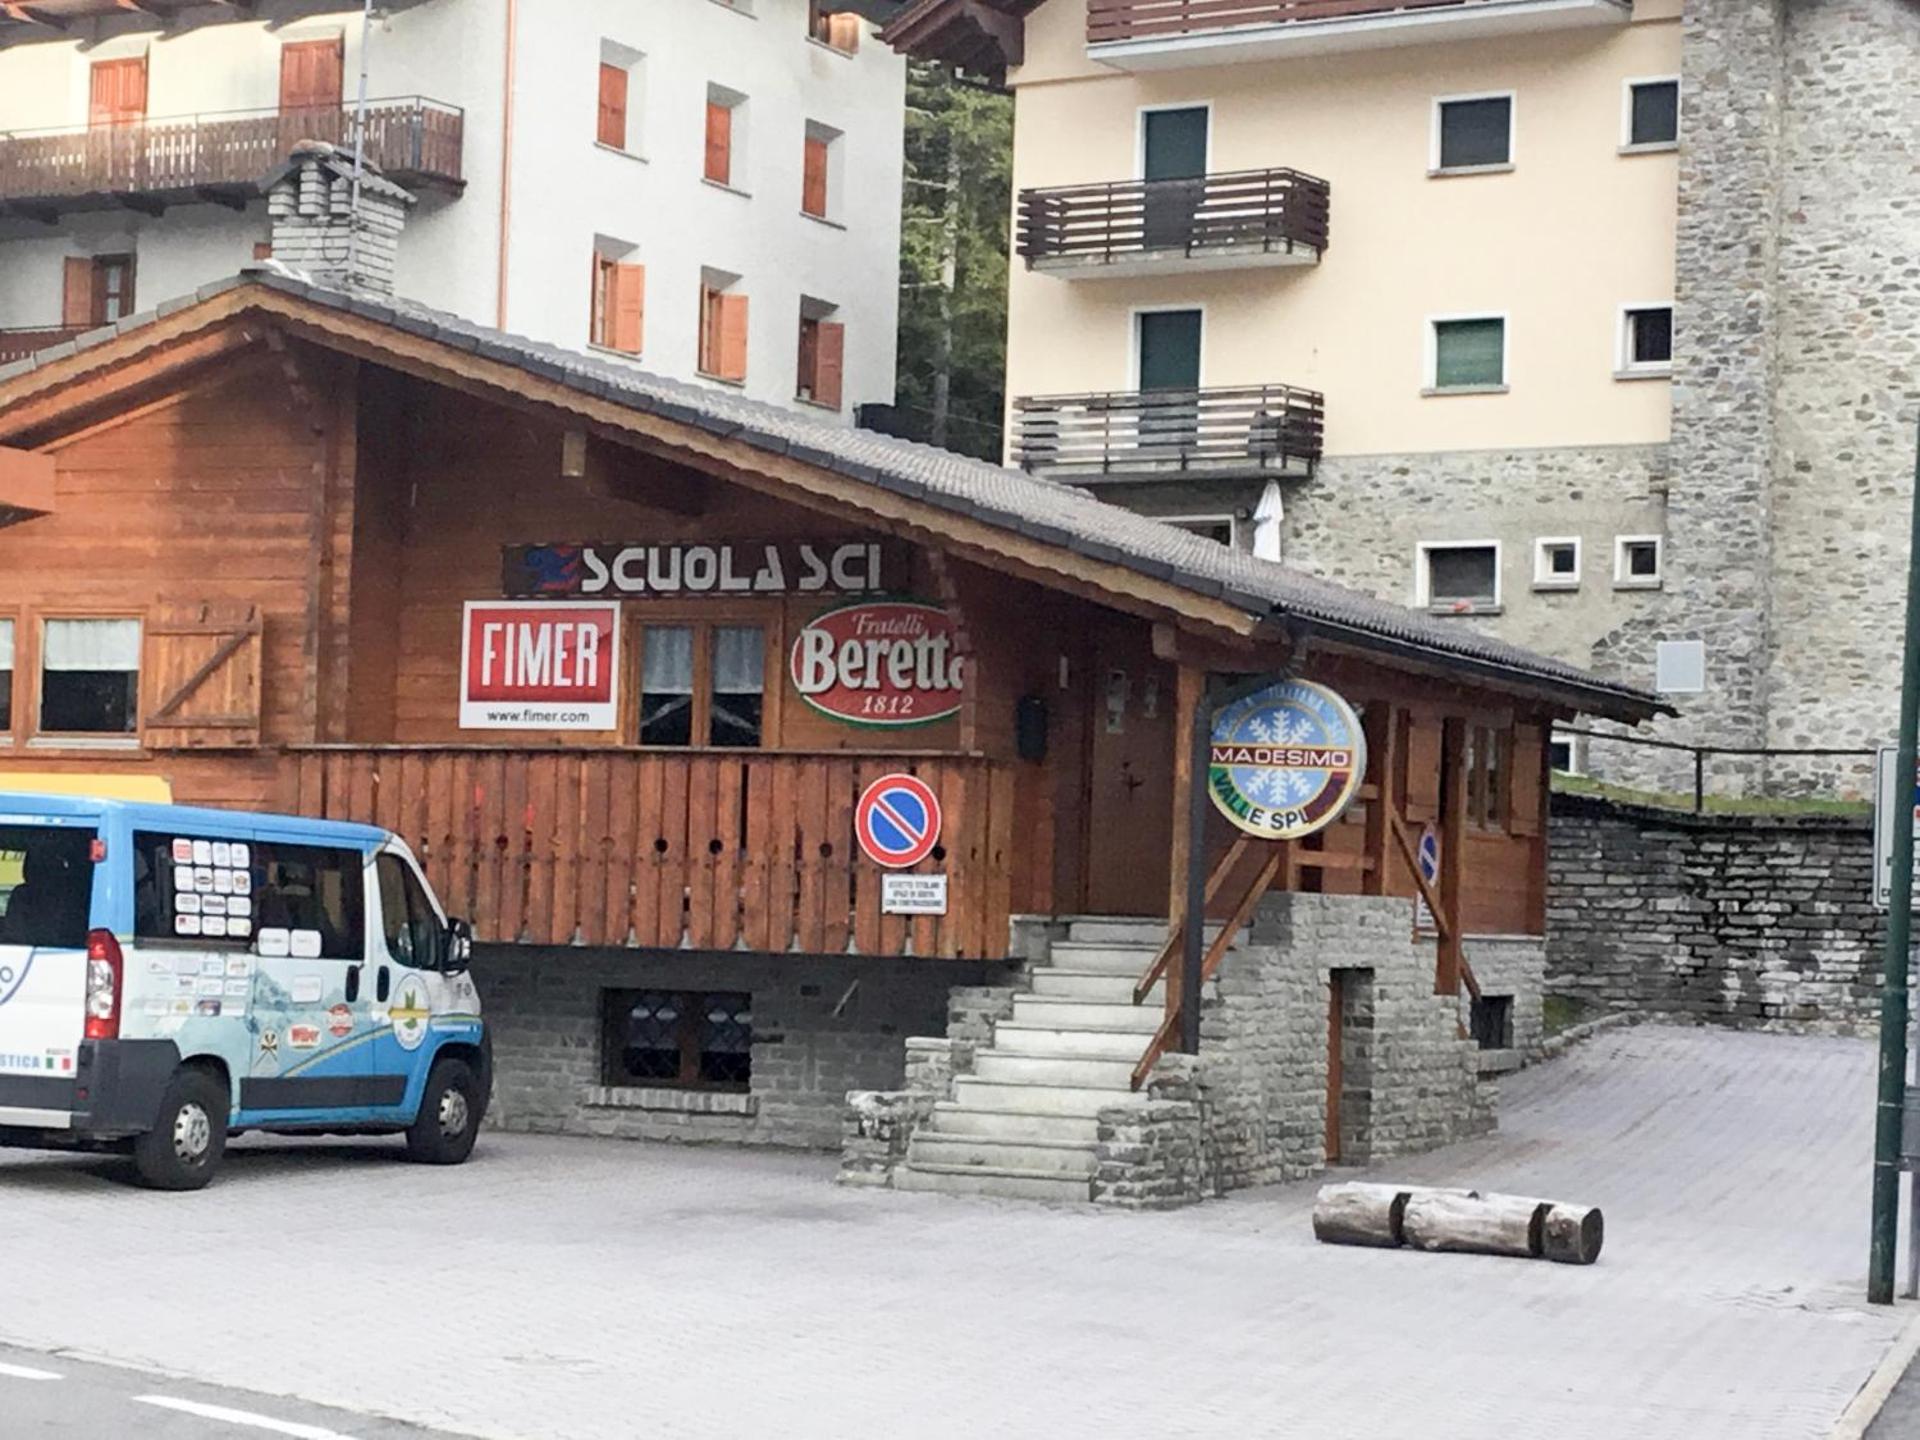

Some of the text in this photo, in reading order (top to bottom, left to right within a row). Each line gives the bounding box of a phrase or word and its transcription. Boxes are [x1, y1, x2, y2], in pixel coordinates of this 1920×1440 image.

[582, 543, 880, 592] SCUOLA SCI
[852, 612, 924, 636] Fratelli
[481, 622, 599, 687] FIMER
[487, 708, 590, 723] www.fimer.com
[861, 694, 914, 714] 1812
[1212, 747, 1349, 767] MADESIMO
[1213, 773, 1263, 826] VALLE
